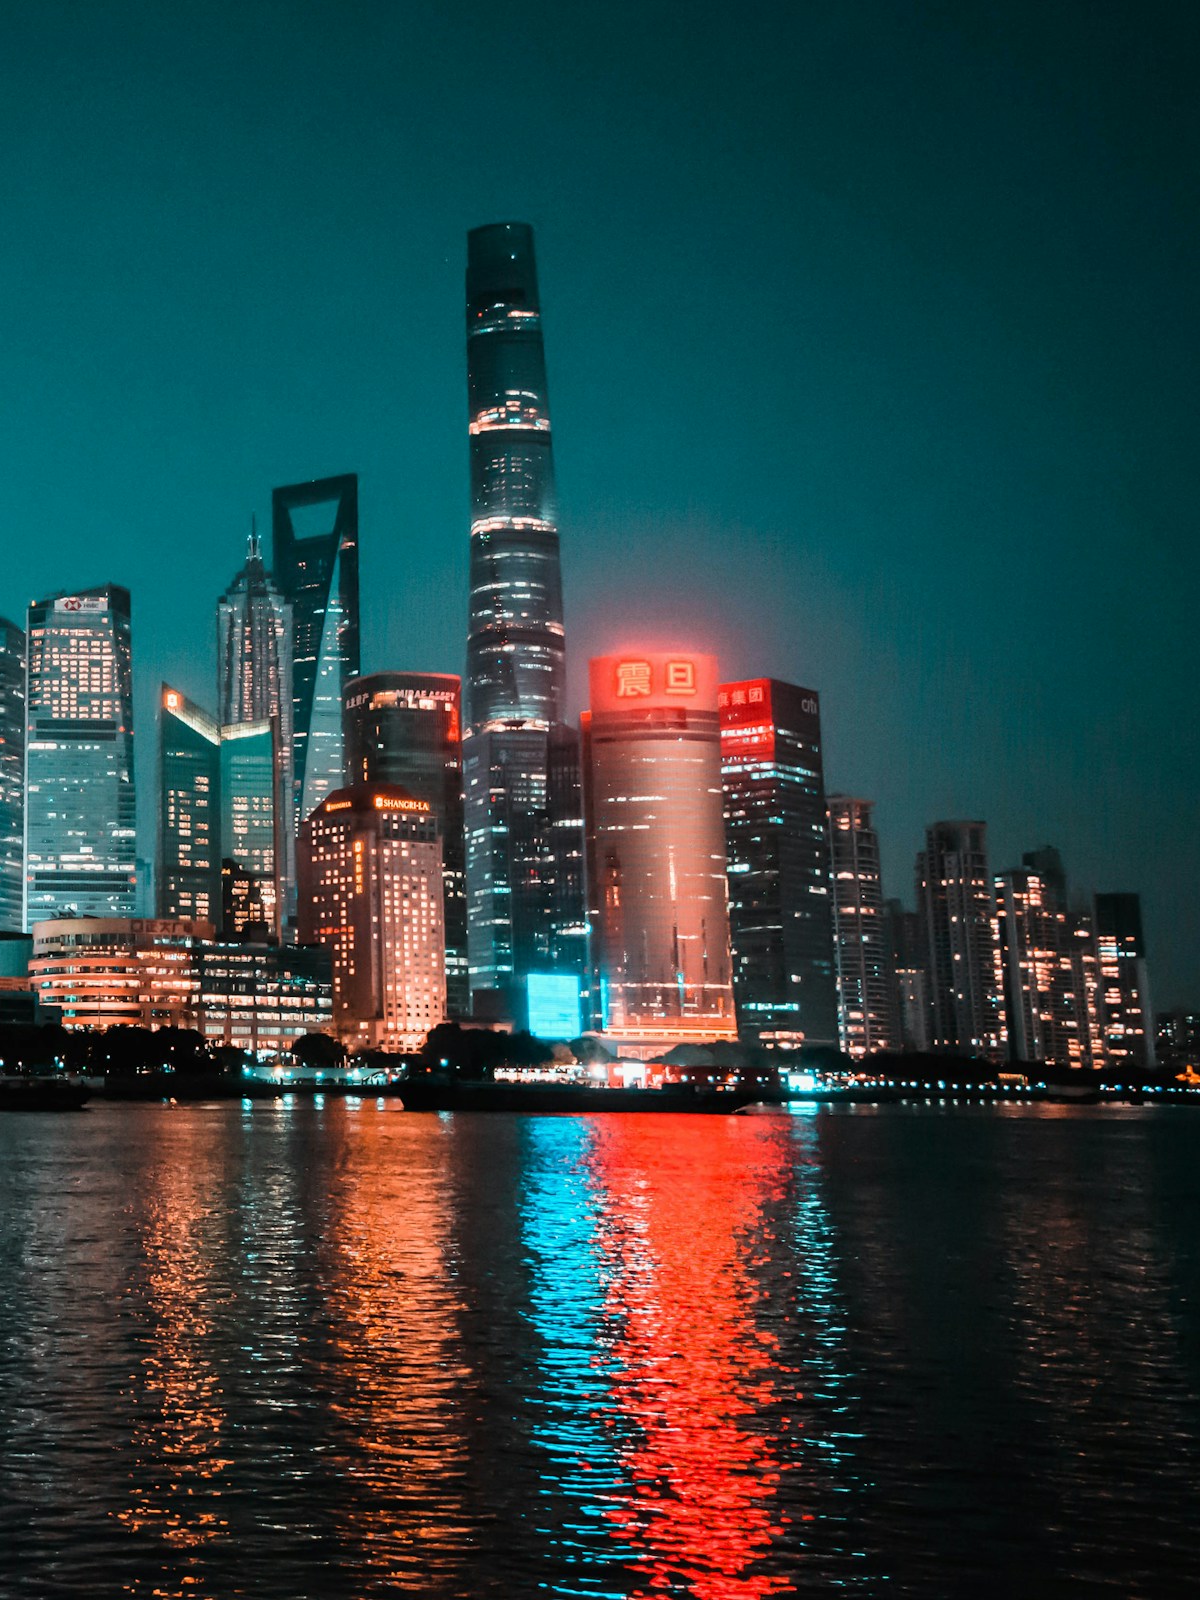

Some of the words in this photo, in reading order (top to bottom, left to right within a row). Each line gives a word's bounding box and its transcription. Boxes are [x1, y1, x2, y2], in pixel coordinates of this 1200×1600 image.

[616, 660, 697, 697] 震旦
[395, 689, 426, 699] MIRAE
[383, 799, 429, 811] SHANGRI-LA
